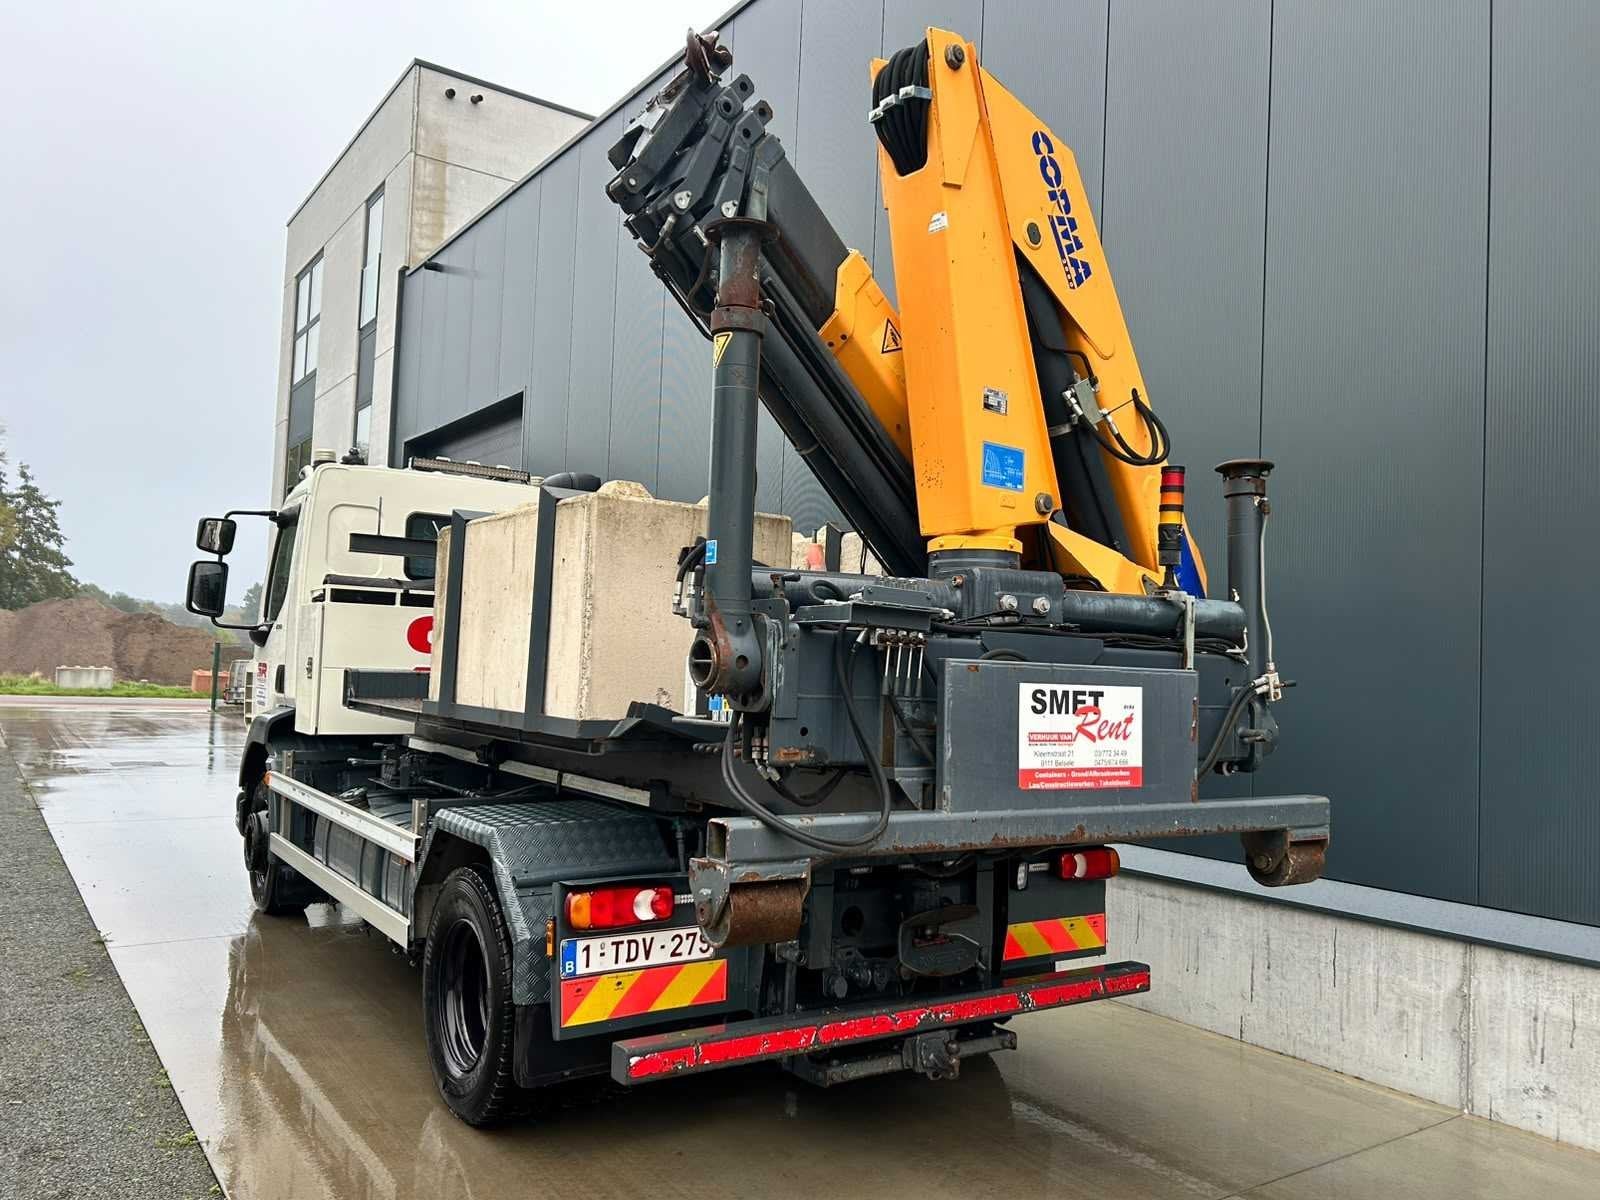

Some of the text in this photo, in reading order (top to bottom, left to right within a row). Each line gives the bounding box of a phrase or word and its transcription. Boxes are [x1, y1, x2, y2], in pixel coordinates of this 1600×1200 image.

[1032, 131, 1092, 288] COPMA
[1031, 689, 1104, 715] SMET
[1060, 733, 1072, 741] VAN
[1073, 705, 1134, 743] Rent
[565, 960, 575, 973] B
